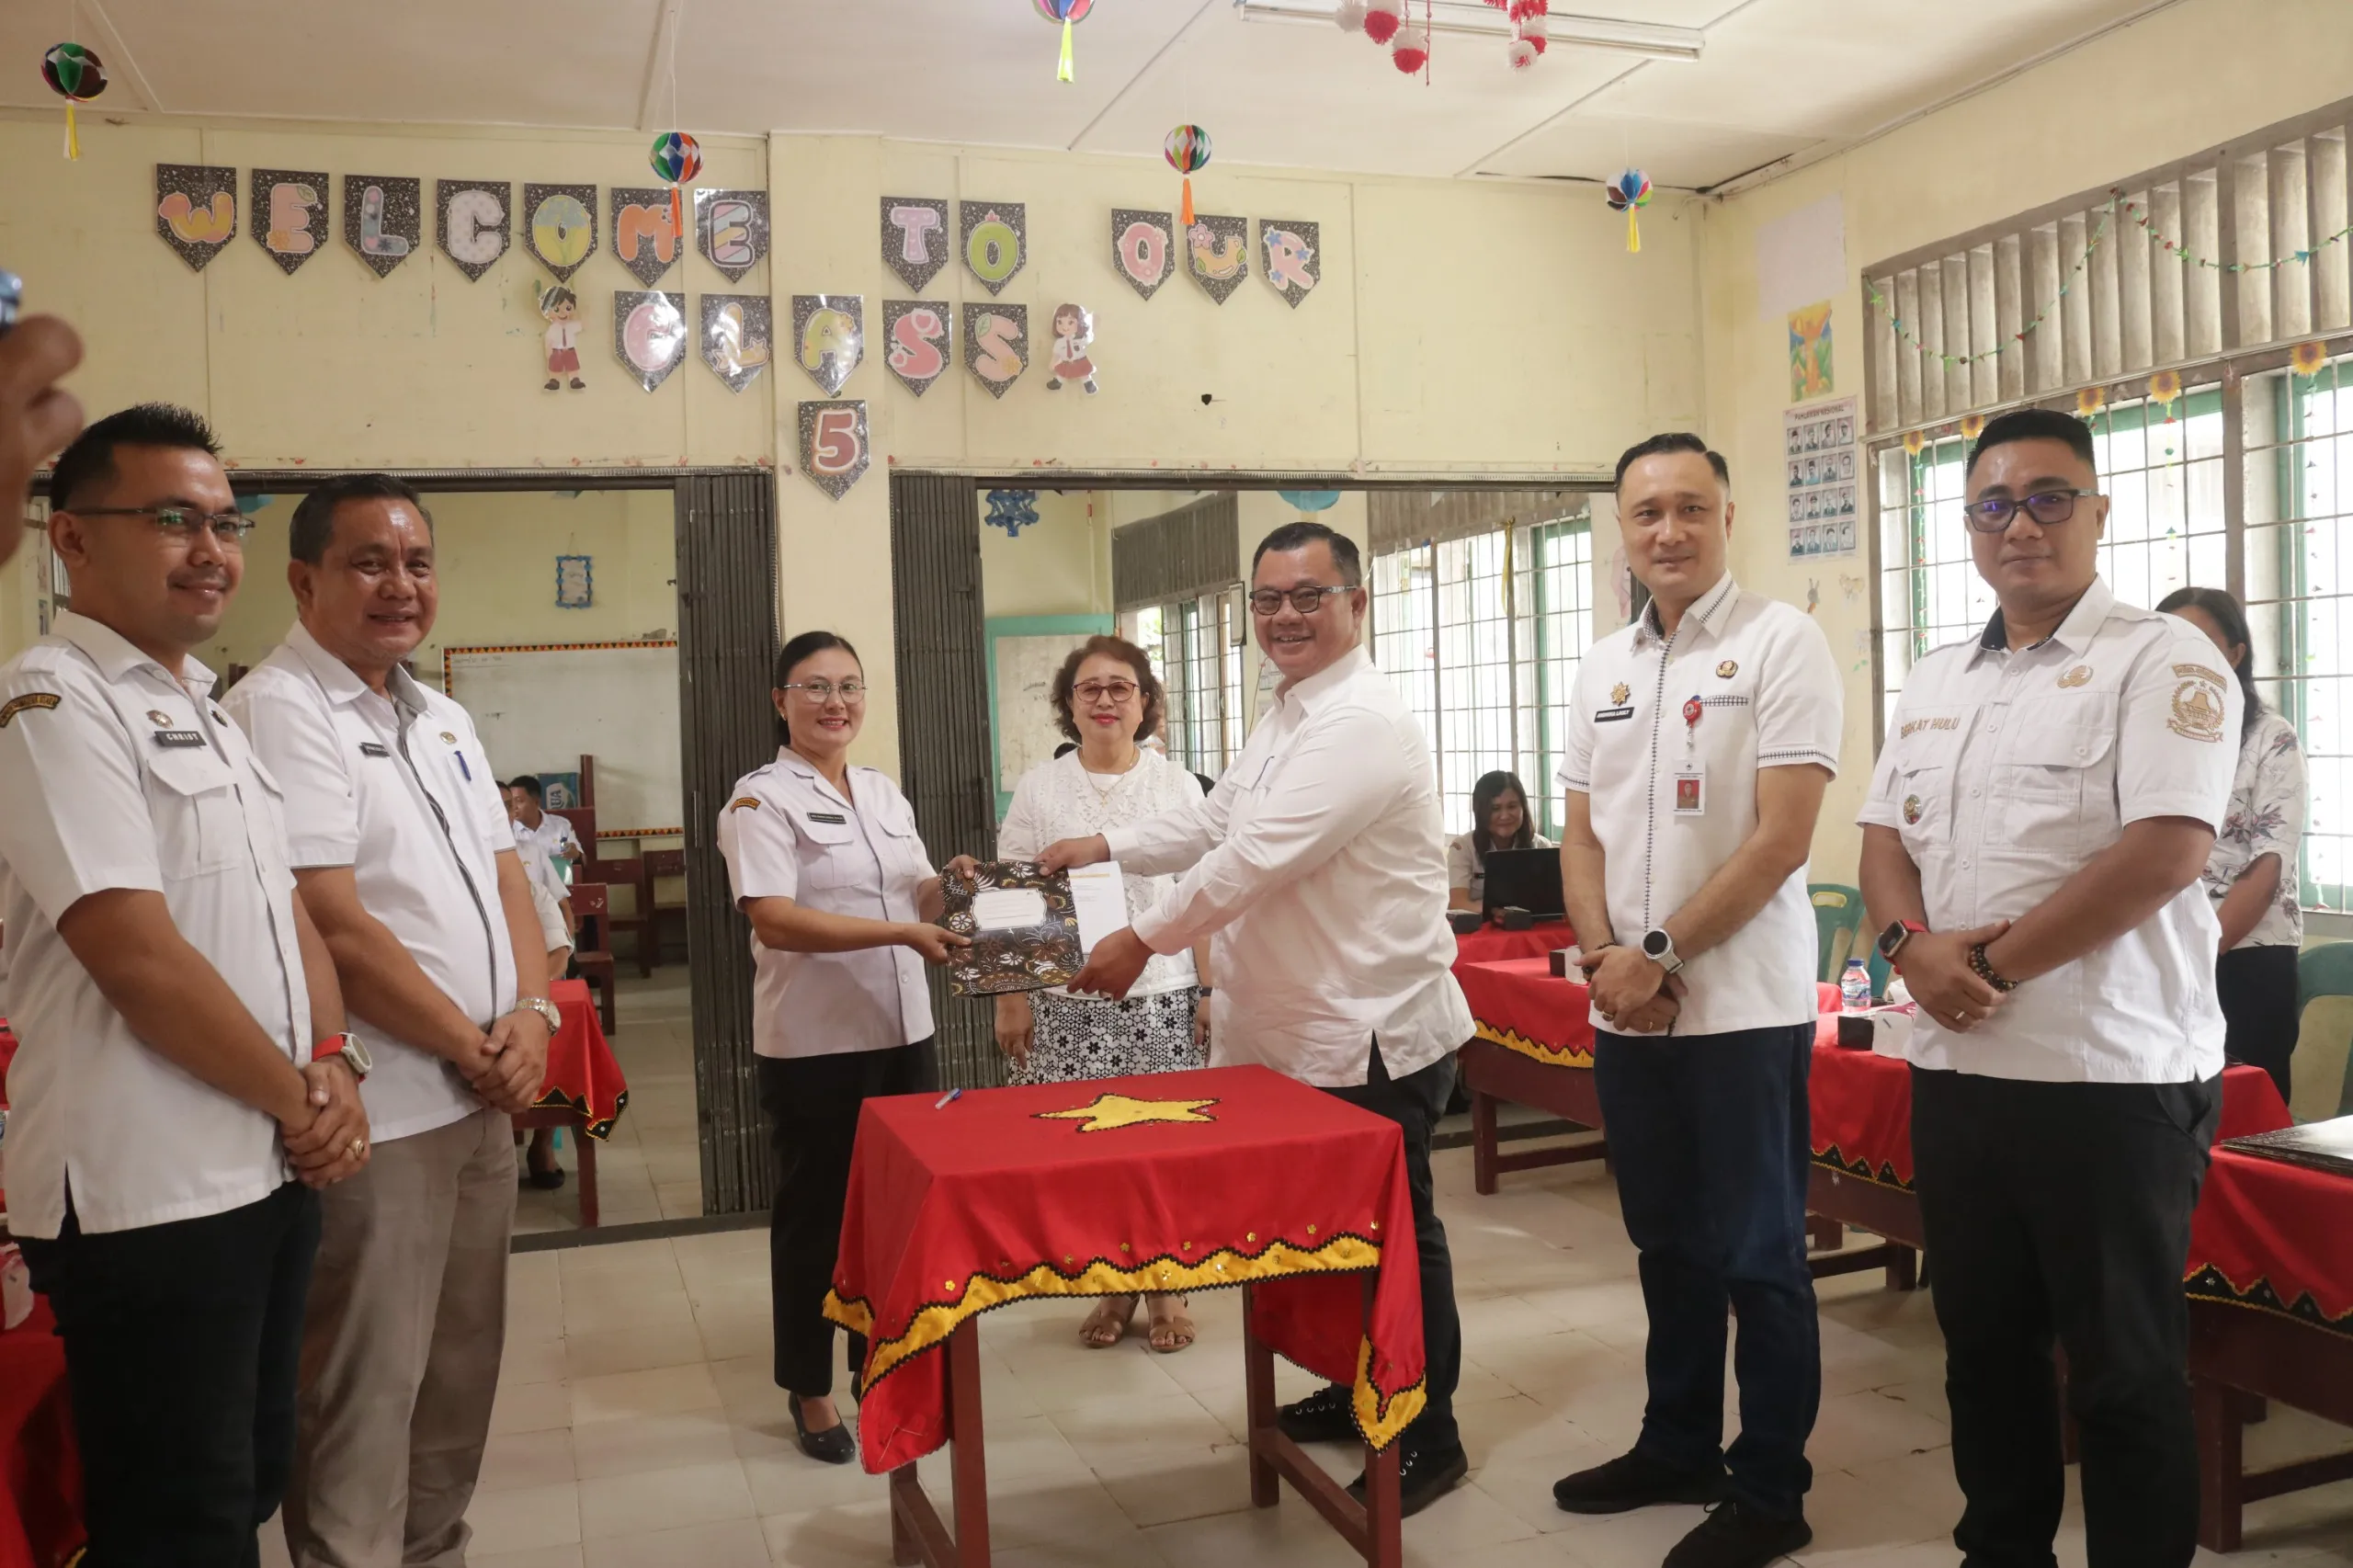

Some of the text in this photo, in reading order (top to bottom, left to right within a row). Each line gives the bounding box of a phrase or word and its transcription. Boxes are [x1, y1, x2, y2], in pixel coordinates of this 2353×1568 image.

[157, 183, 1314, 291] WELCOME TO OUR
[622, 301, 1023, 381] CLASS
[812, 409, 860, 475] 5
[165, 733, 199, 741] CHRIST
[1930, 717, 1961, 731] HULU
